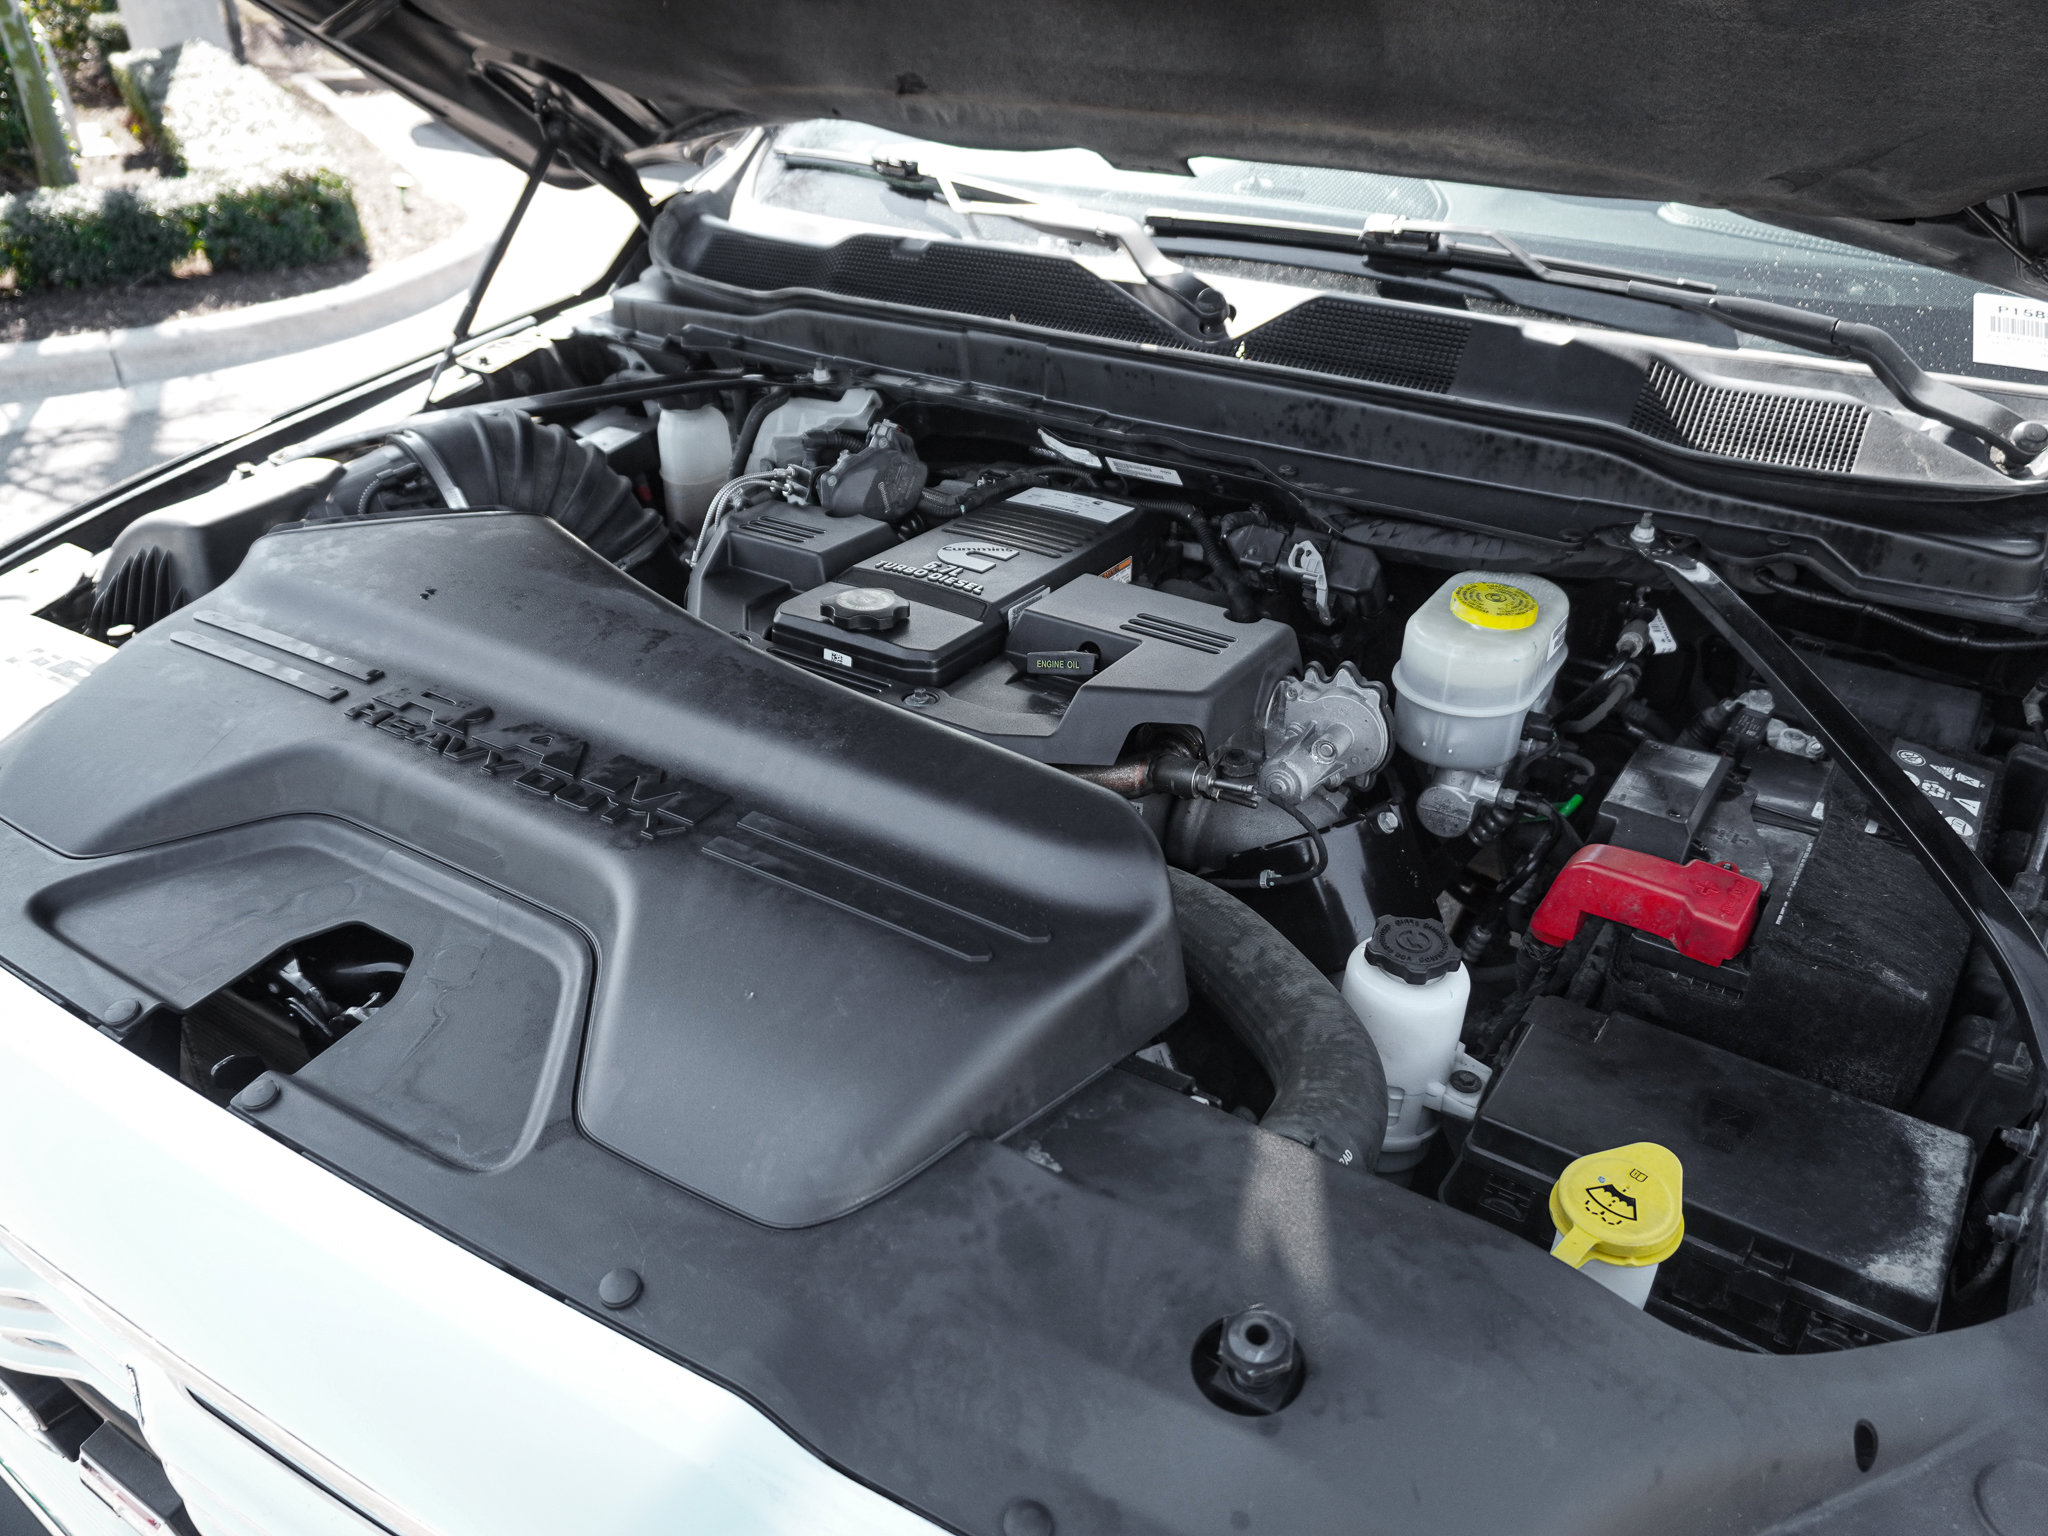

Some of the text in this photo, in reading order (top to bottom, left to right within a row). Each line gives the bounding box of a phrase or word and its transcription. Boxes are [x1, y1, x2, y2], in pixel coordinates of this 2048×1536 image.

[1998, 305, 2048, 319] P158
[874, 560, 985, 596] TURBO DIESEL
[922, 561, 964, 577] 6.7L
[1036, 660, 1080, 669] ENGINE OIL
[371, 685, 733, 825] RAM
[344, 702, 687, 840] HEAVY DUTY
